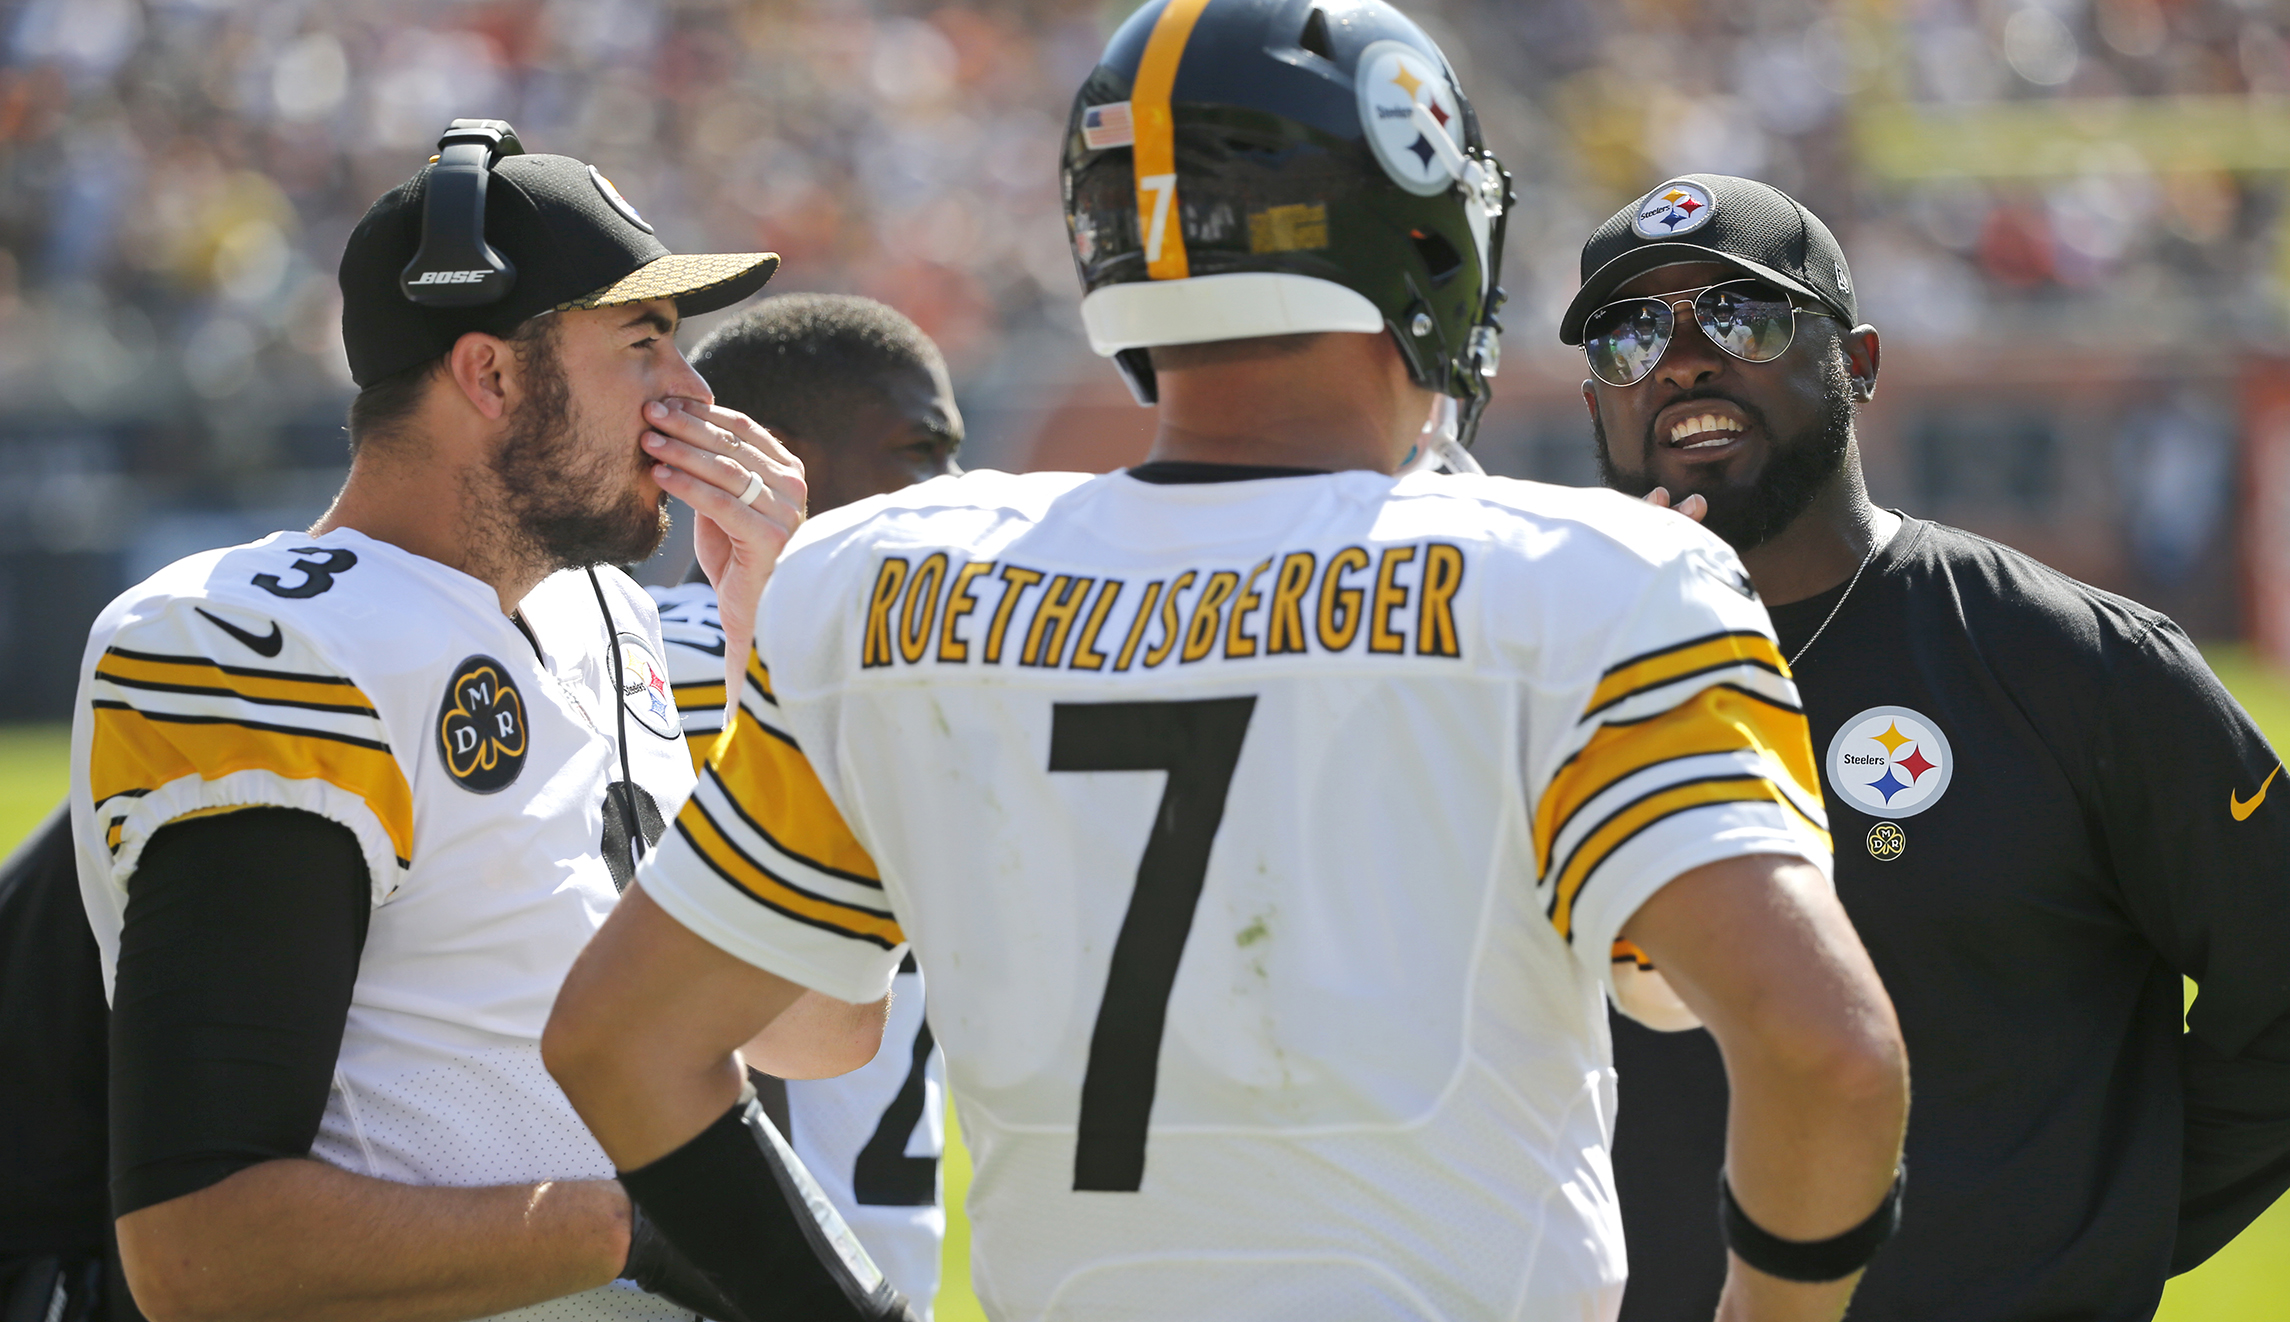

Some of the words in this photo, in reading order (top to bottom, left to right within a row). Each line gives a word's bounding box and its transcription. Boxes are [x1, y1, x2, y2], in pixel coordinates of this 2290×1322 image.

[1140, 173, 1177, 262] 7
[1640, 205, 1671, 220] Steelers
[408, 269, 495, 285] BOSE
[251, 547, 358, 599] 3
[862, 543, 1461, 672] ROETHLISBERGER
[1844, 753, 1885, 766] Steelers
[1048, 694, 1259, 1192] 7
